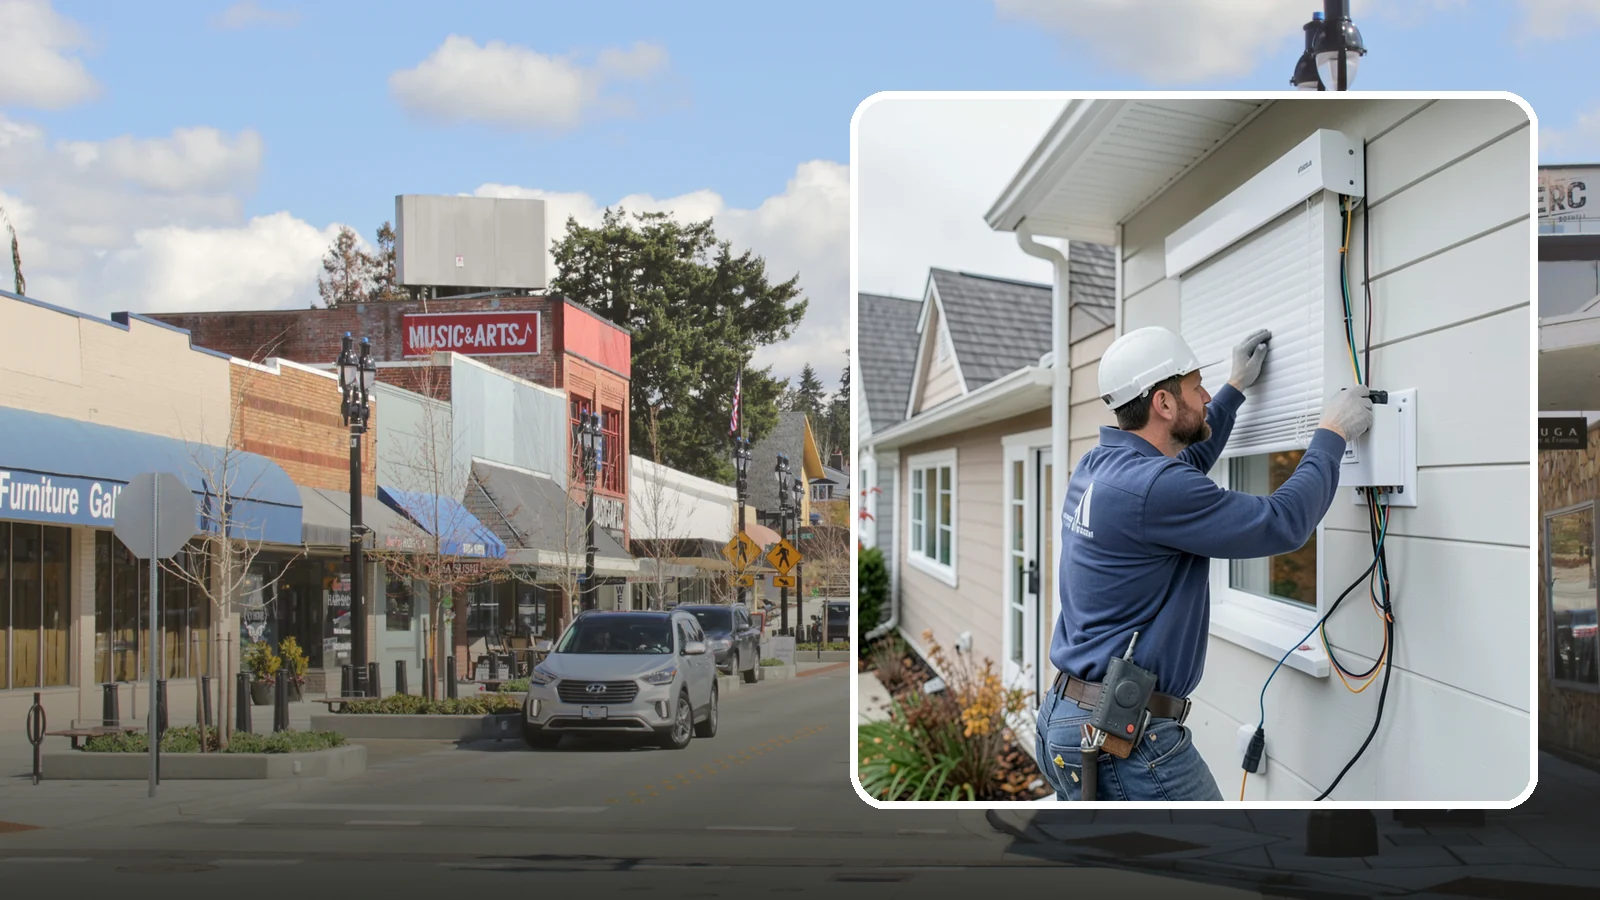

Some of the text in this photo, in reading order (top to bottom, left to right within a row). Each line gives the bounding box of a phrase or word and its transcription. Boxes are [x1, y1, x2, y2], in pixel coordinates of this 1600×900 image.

[408, 322, 520, 349] MUSIC&ARTS
[1540, 427, 1577, 436] UGA
[0, 471, 122, 519] Furniture Gal
